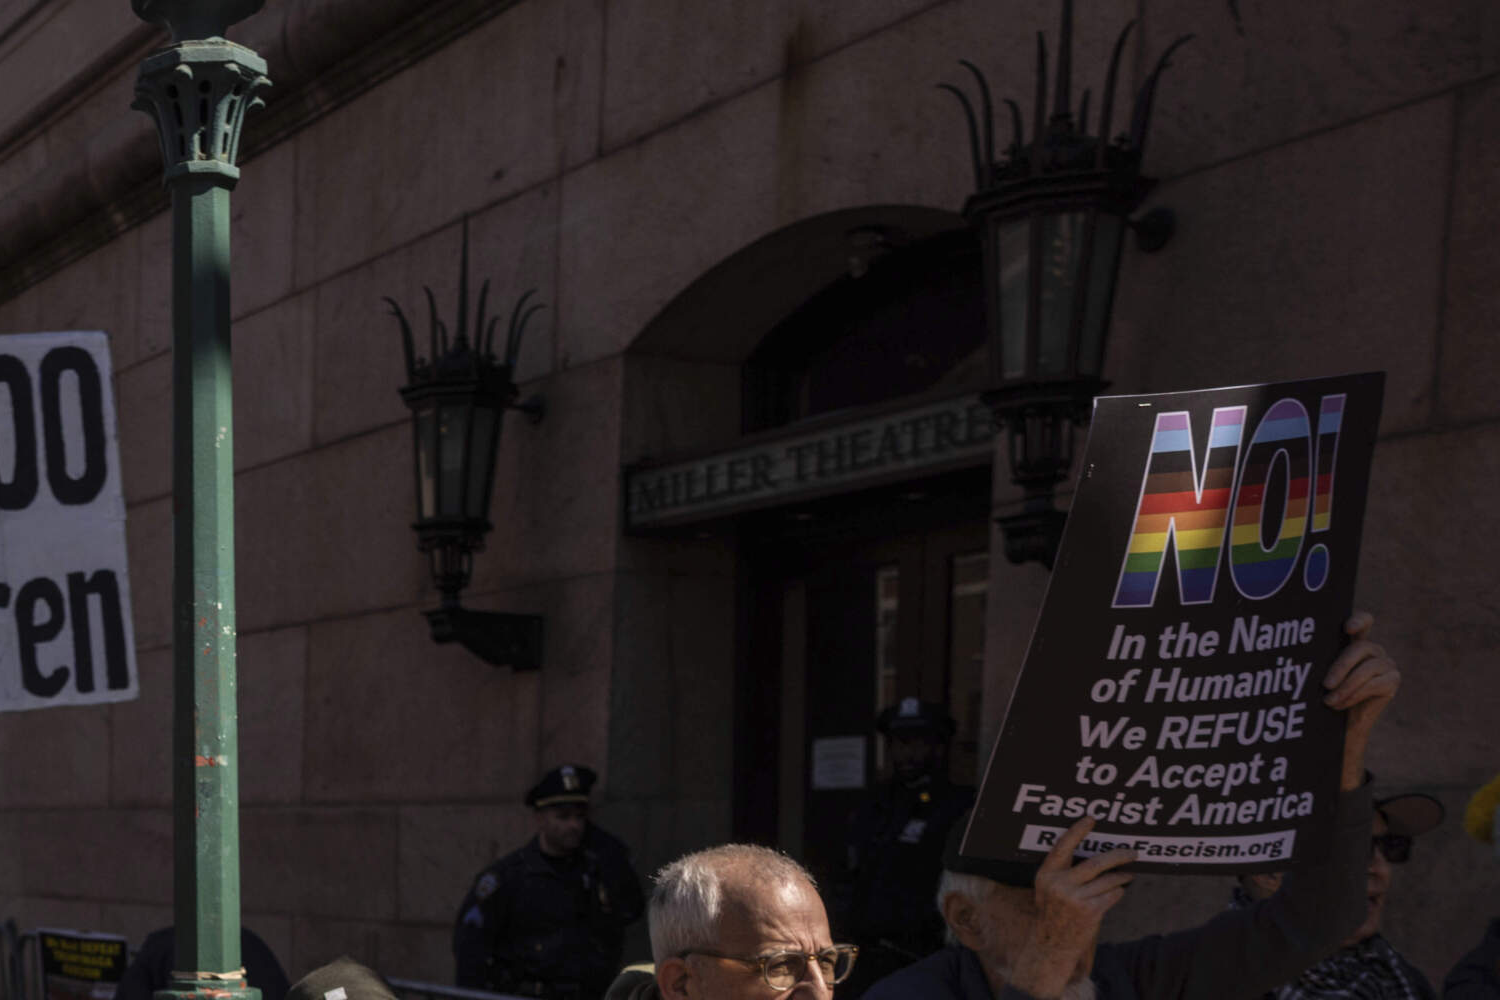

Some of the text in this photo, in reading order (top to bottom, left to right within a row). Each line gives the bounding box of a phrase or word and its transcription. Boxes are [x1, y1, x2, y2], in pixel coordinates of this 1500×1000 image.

[631, 405, 995, 513] MILLER THEATRE
[1110, 393, 1347, 609] NO!
[1106, 614, 1316, 660] In the Name
[1090, 656, 1312, 704] of Humanity
[1078, 703, 1307, 751] We REFUSE
[1075, 752, 1288, 796] to Accept a
[1012, 783, 1315, 827] Fascist America
